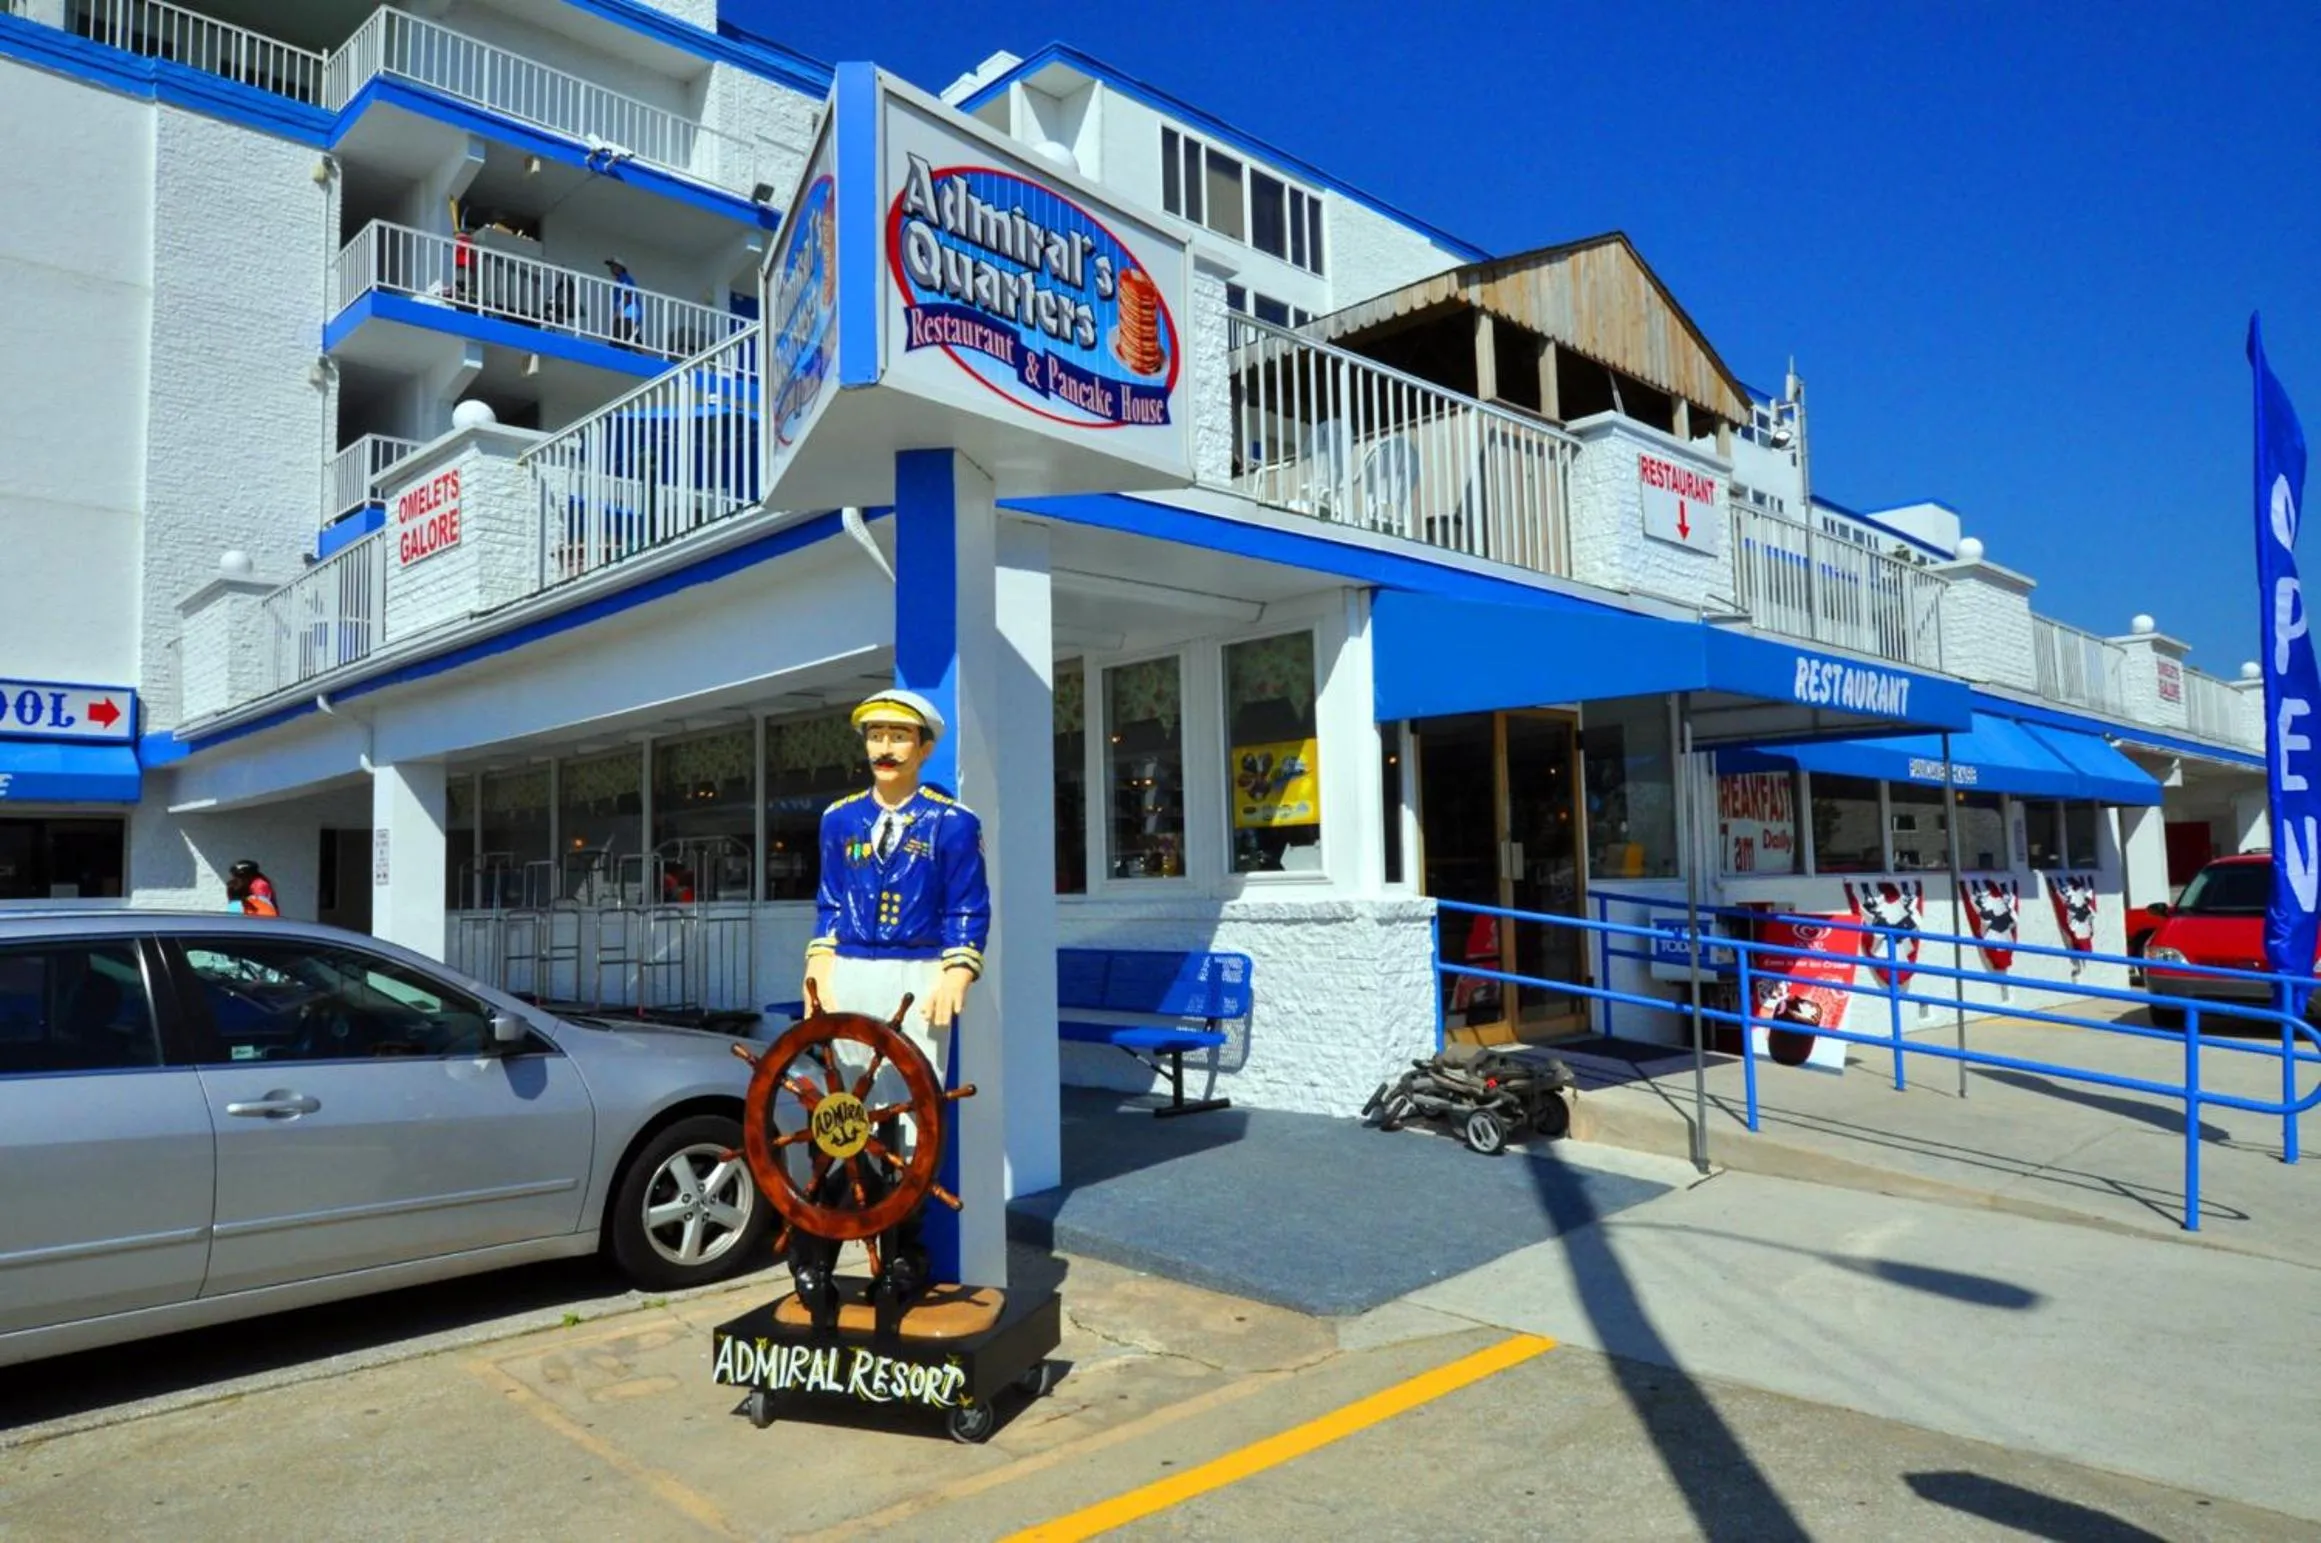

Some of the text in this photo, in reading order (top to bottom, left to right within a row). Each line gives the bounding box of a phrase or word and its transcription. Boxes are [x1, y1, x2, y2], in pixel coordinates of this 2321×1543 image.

[900, 151, 1115, 301] Admiral's
[902, 219, 1098, 349] Quarters
[911, 307, 1165, 424] Restaurant & Pancake House
[398, 469, 460, 525] OMELETS
[1640, 454, 1716, 507] RESTAURANT
[400, 510, 459, 564] GALORE
[0, 688, 76, 729] OL
[1794, 656, 1910, 717] RESTAURANT
[1717, 773, 1794, 823] REAKFAST
[1734, 836, 1756, 874] am
[1762, 828, 1794, 854] Daily
[1660, 939, 1703, 955] TOD
[713, 1335, 967, 1408] ADMIRAL RESORT
